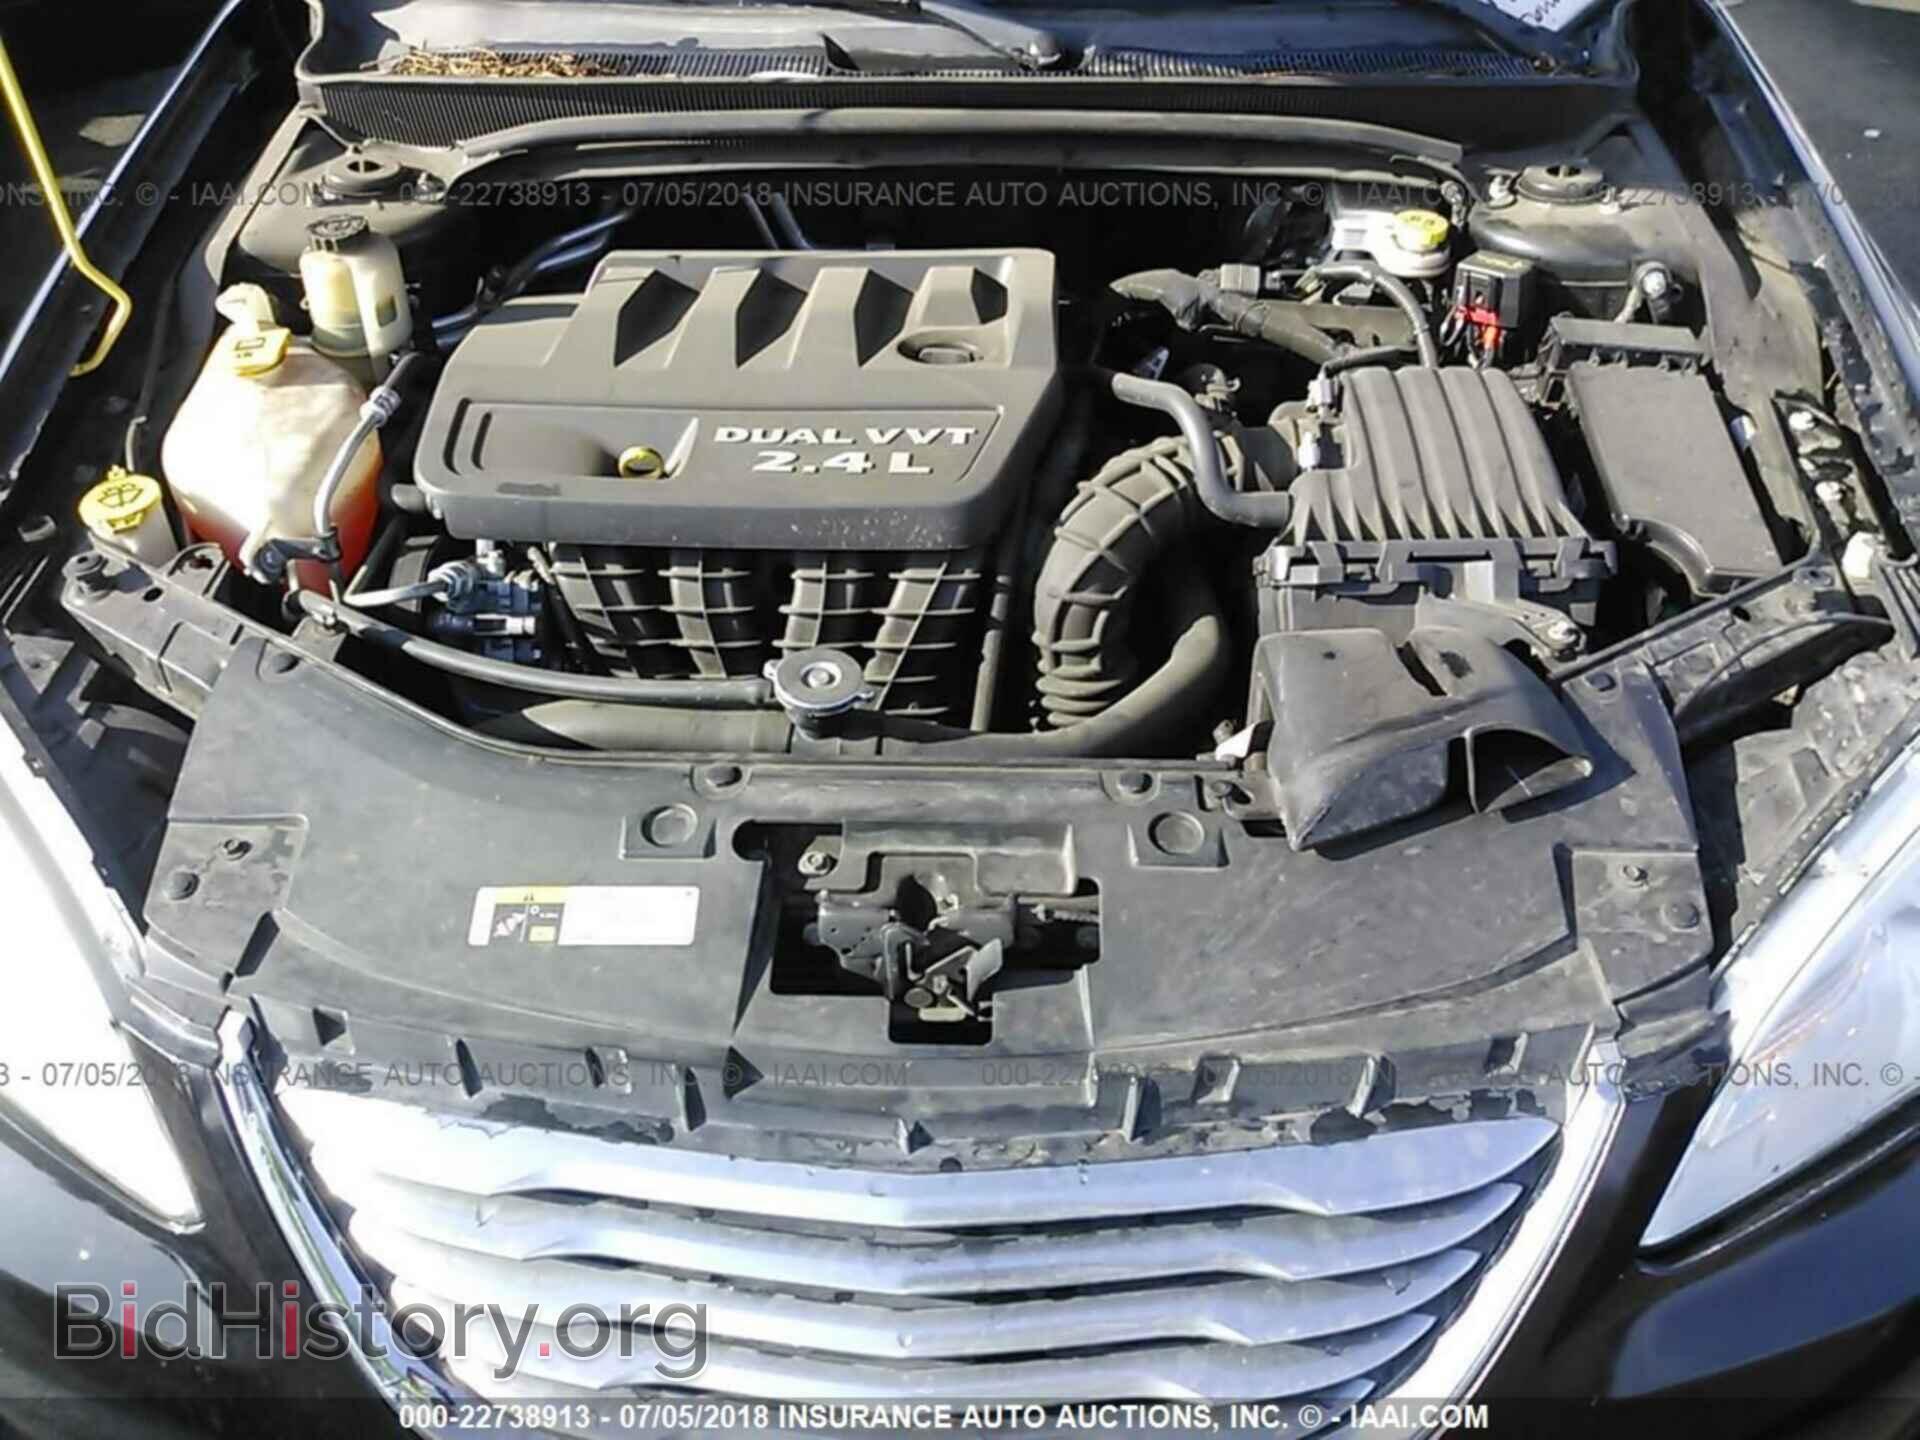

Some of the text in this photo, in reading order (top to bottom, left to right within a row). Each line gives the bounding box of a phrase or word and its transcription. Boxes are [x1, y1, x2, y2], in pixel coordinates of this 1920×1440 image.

[714, 427, 979, 445] DUAL VVT
[752, 451, 875, 474] 2.4
